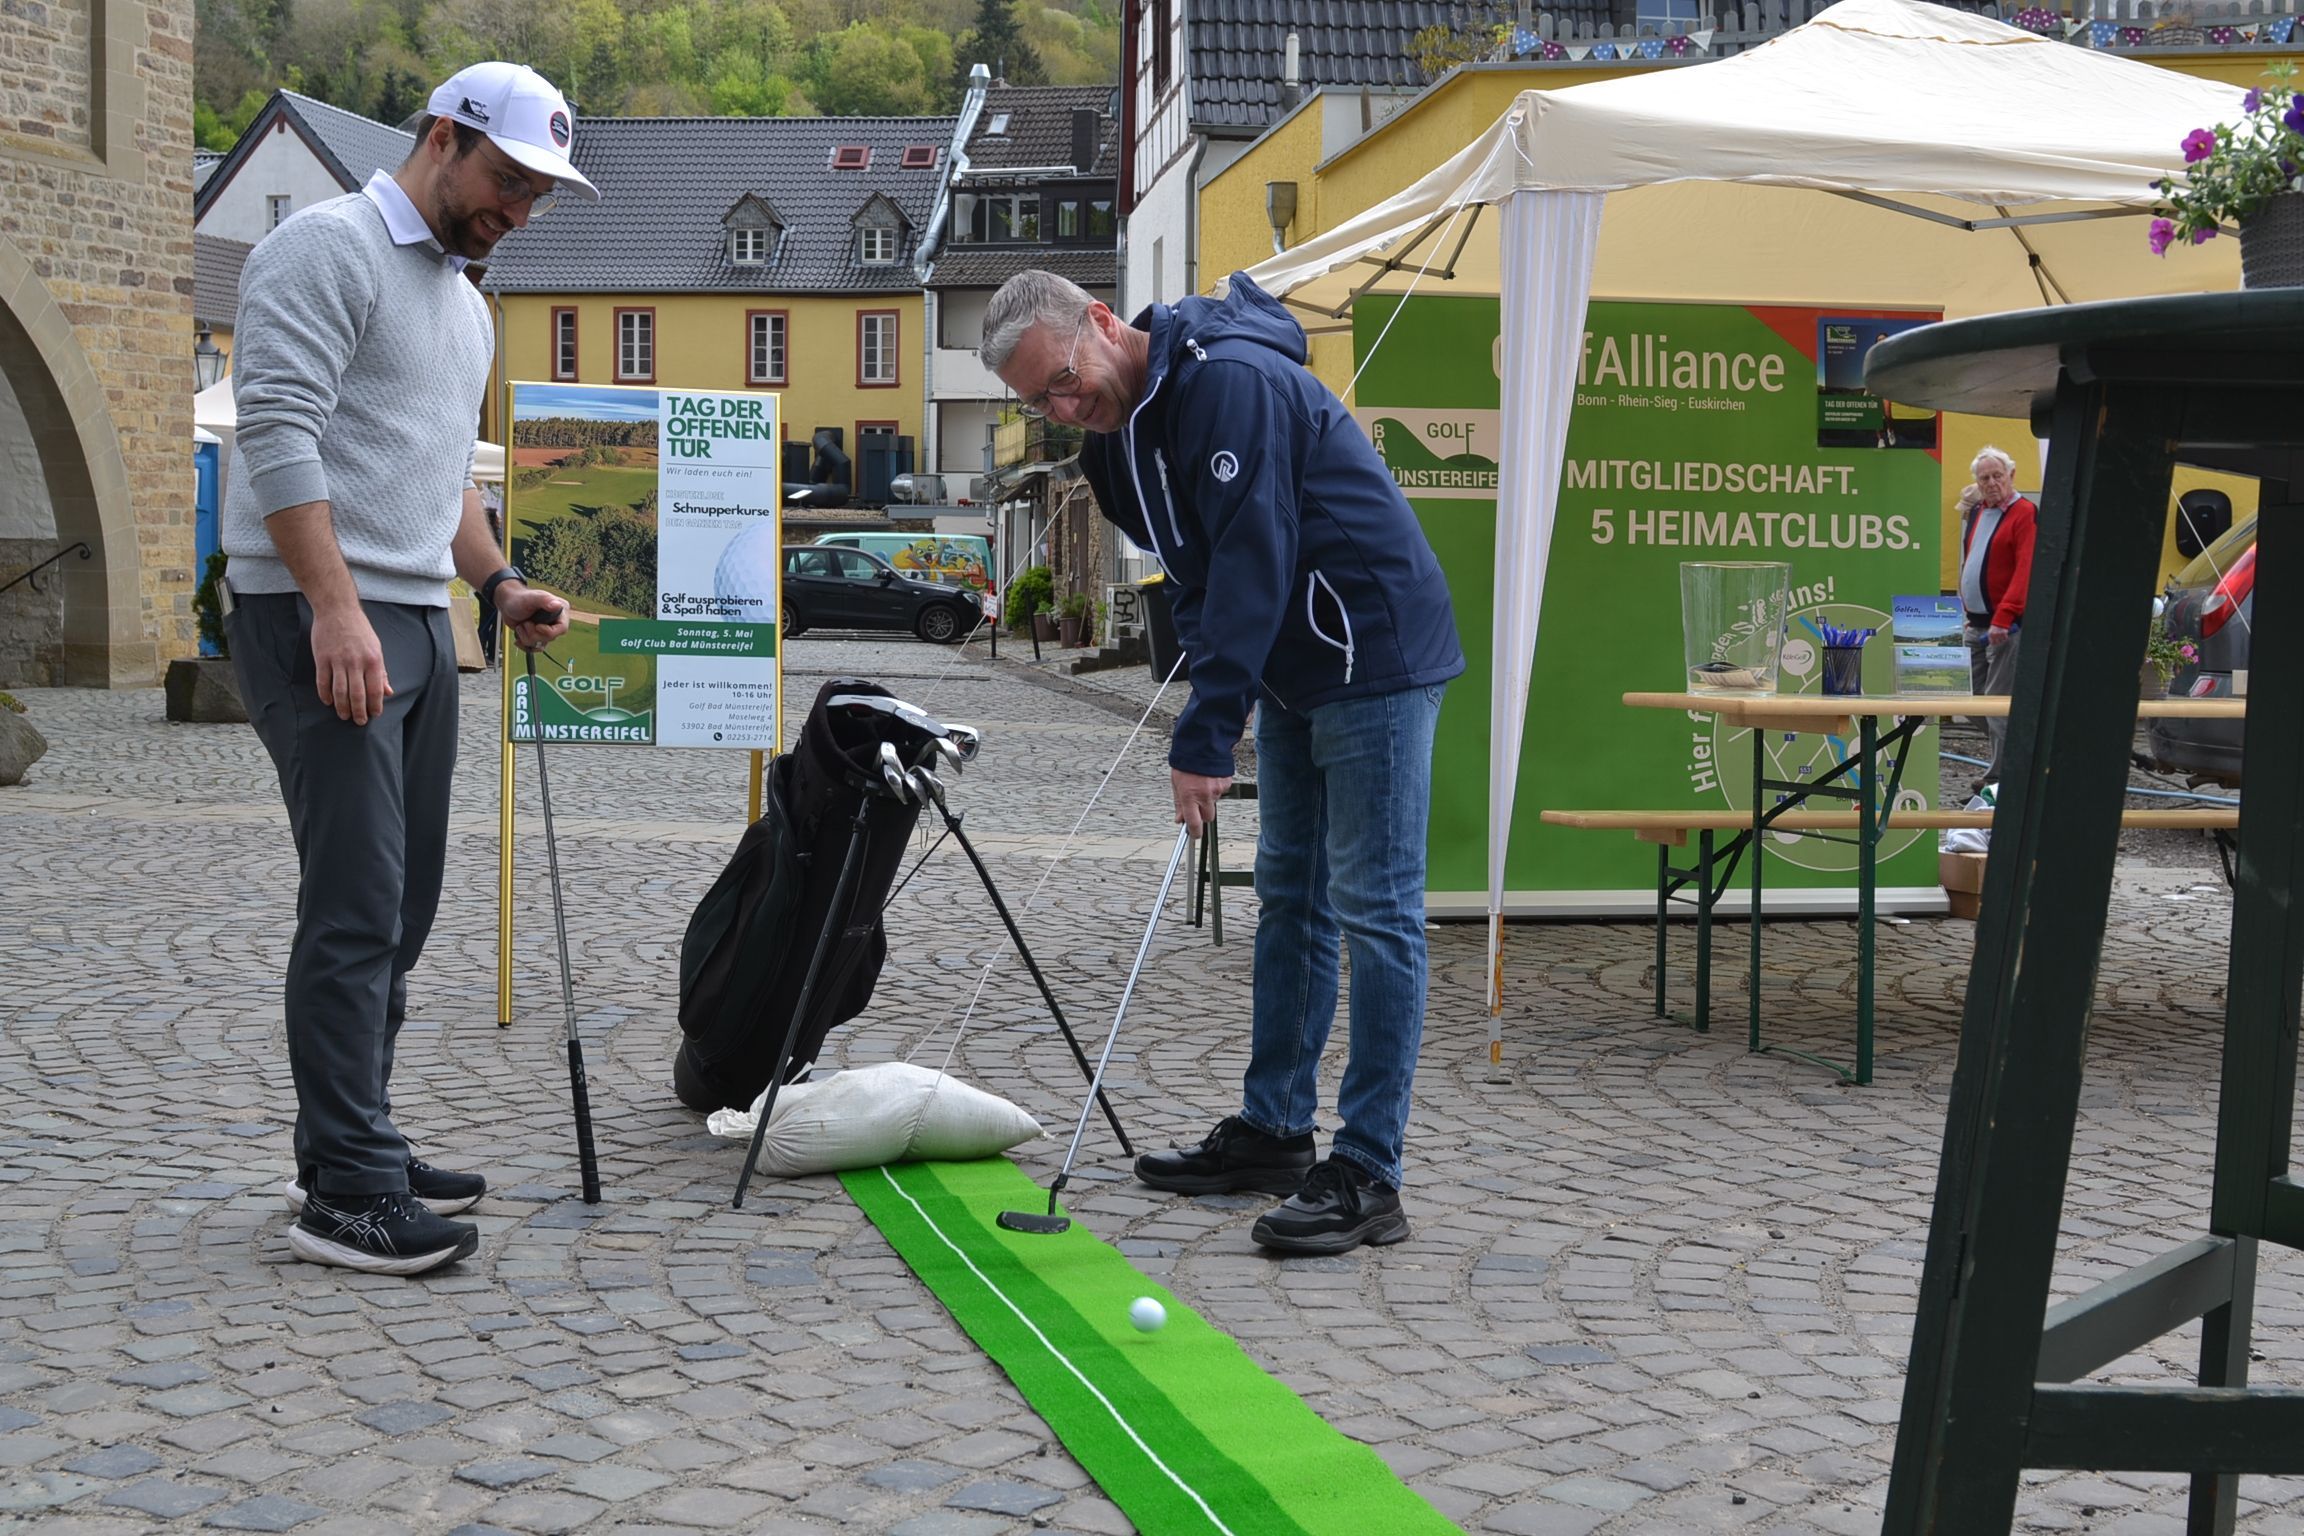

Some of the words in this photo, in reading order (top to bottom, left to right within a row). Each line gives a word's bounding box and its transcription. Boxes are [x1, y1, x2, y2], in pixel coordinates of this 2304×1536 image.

[1492, 331, 1785, 392] fAlliance
[666, 396, 716, 417] TAG
[720, 399, 765, 419] DER
[1577, 394, 1607, 406] Bonn
[1618, 395, 1678, 411] Rhein-Sieg
[1688, 397, 1746, 411] Euskirchen
[666, 417, 771, 440] OFFENEN
[1426, 422, 1476, 439] GOLF
[666, 437, 713, 459] TÜR
[666, 467, 682, 475] Wir
[684, 467, 709, 477] laden
[712, 468, 733, 478] euch
[736, 470, 753, 478] ein!
[1390, 466, 1499, 488] ÜNSTEREIFE
[1567, 459, 1858, 496] MITGLIEDSCHAFT.
[672, 502, 770, 517] Schnupperkurse
[1591, 508, 1615, 545] 5
[1627, 509, 1921, 550] HEIMATCLUBS.
[661, 593, 686, 603] Golf
[687, 594, 764, 608] ausprobieren
[661, 603, 672, 614] &
[673, 603, 704, 617] Spaß
[705, 604, 742, 616] haben
[676, 627, 720, 639] Sonntag,
[723, 629, 732, 638] 5.
[734, 629, 754, 639] Mai
[620, 638, 643, 649] Golf
[644, 639, 666, 648] Club
[669, 640, 688, 649] Bad
[690, 640, 753, 652] Münstereifel
[557, 677, 624, 692] GOLF
[662, 680, 690, 690] Jeder
[692, 680, 705, 689] ist
[708, 681, 772, 690] willkommen!
[516, 681, 529, 724] BAD
[756, 691, 772, 699] Uhr
[689, 702, 706, 711] Golf
[707, 702, 722, 710] Bad
[724, 702, 773, 712] Münstereifel
[728, 713, 765, 722] Moselweg
[681, 722, 706, 730] 53902
[724, 723, 773, 732] Münstereifel
[1687, 732, 1717, 793] Hier
